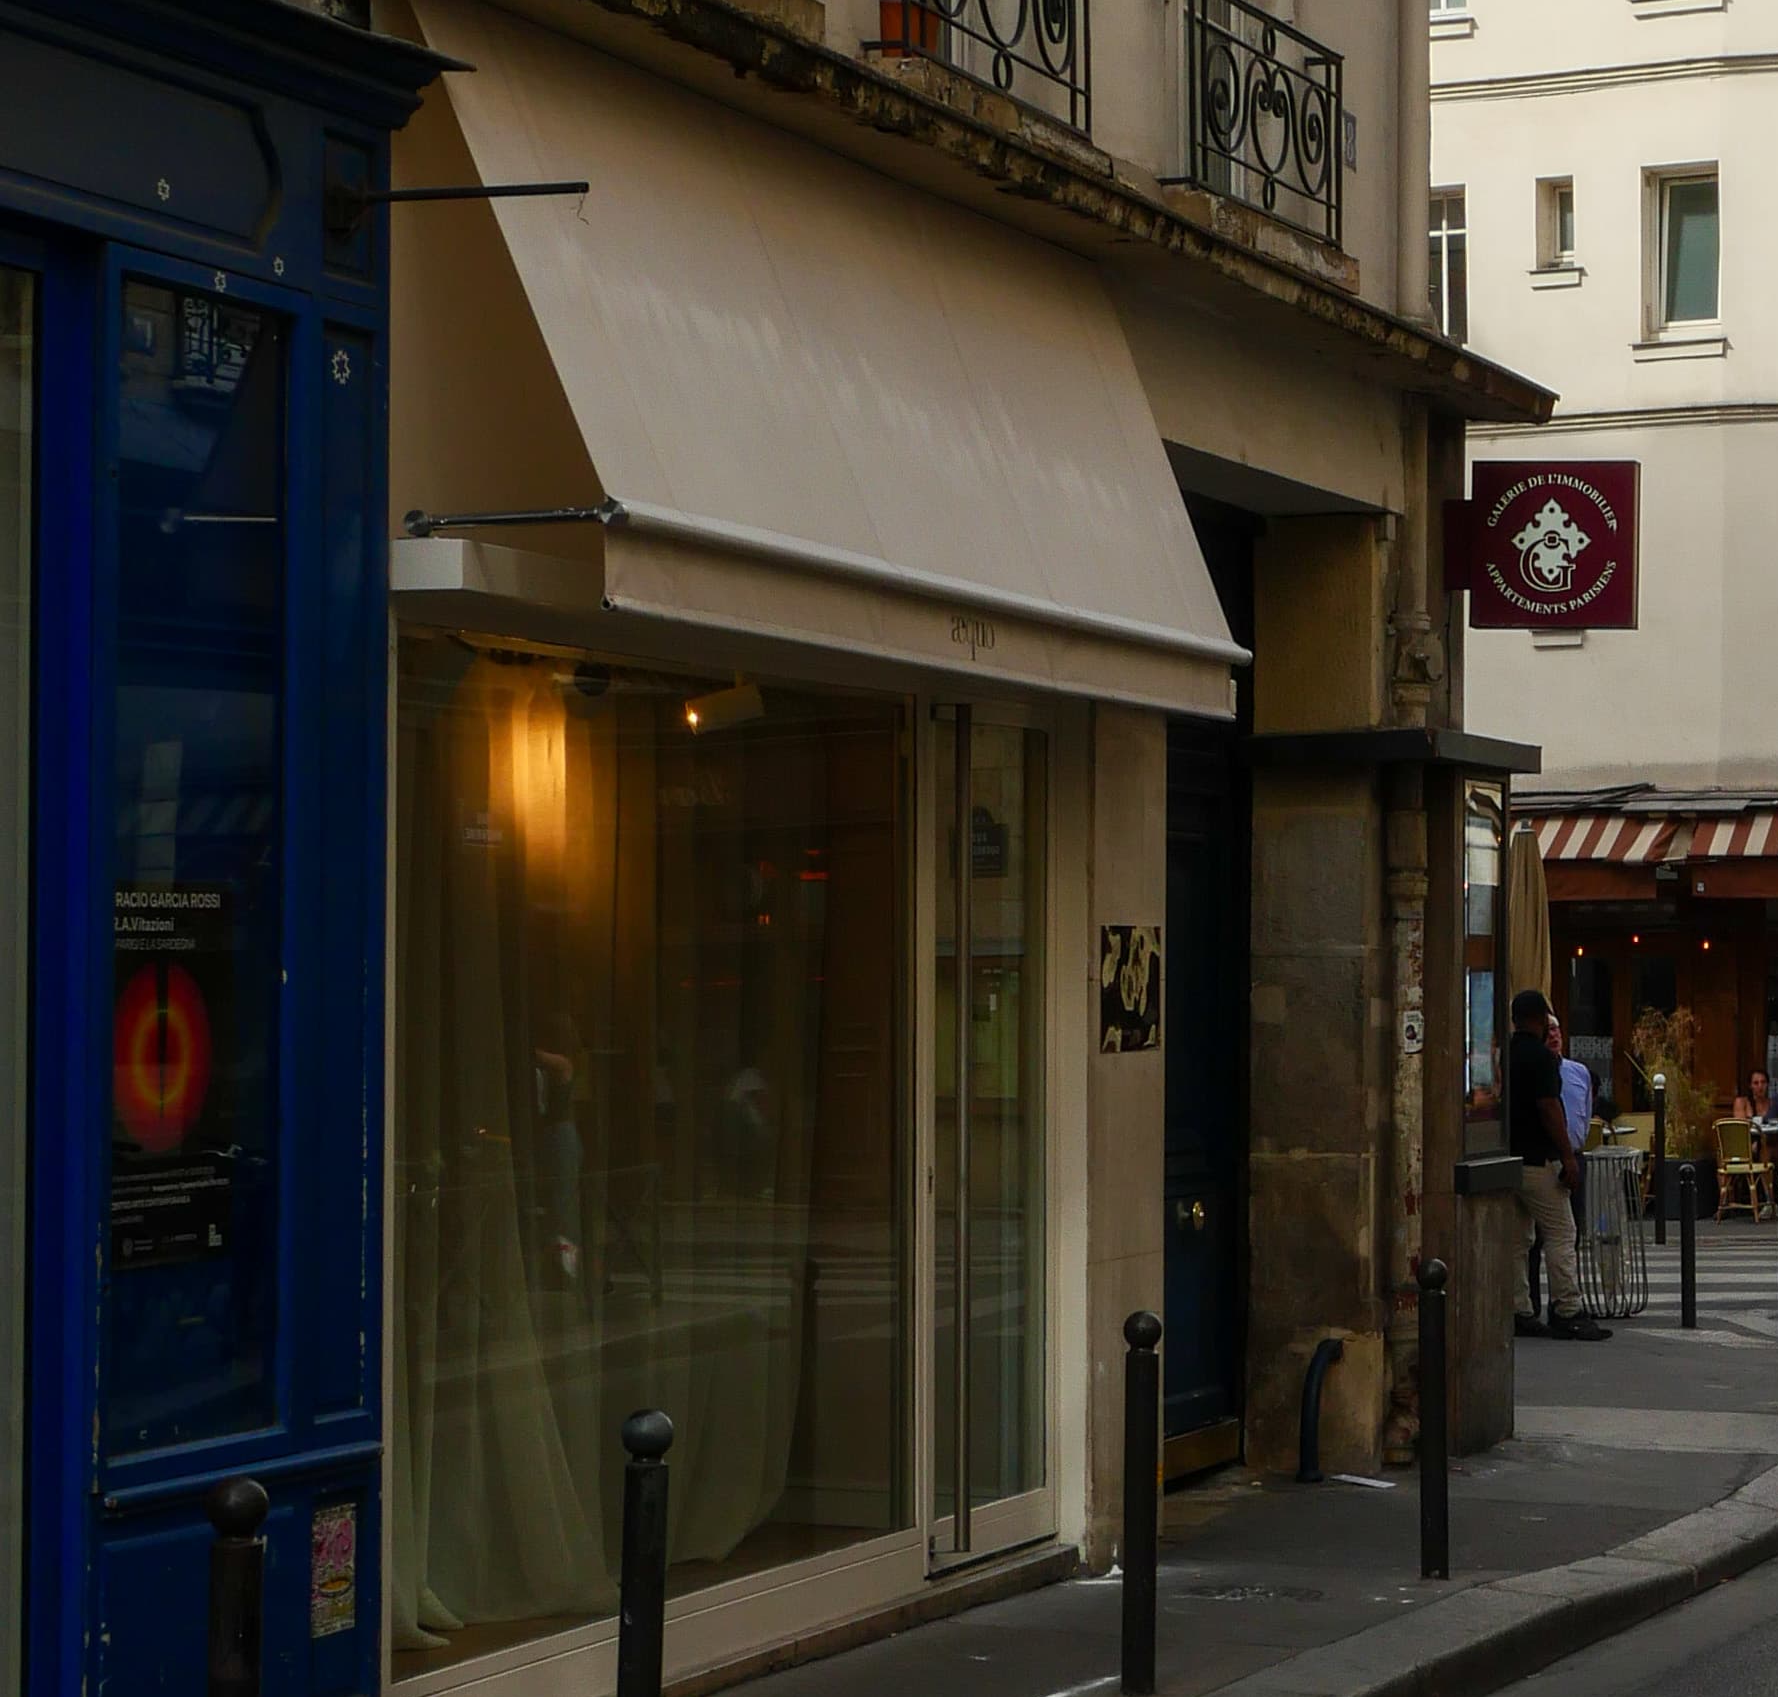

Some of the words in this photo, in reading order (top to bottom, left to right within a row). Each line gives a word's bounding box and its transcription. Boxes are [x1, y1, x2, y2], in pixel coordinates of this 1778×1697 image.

[1487, 481, 1528, 527] GALERIE
[1527, 474, 1546, 489] DE
[1486, 561, 1568, 615] APPARTEMENTS
[1569, 559, 1617, 611] PARISIENS
[150, 892, 189, 909] GARCIA
[191, 893, 221, 909] ROSSI
